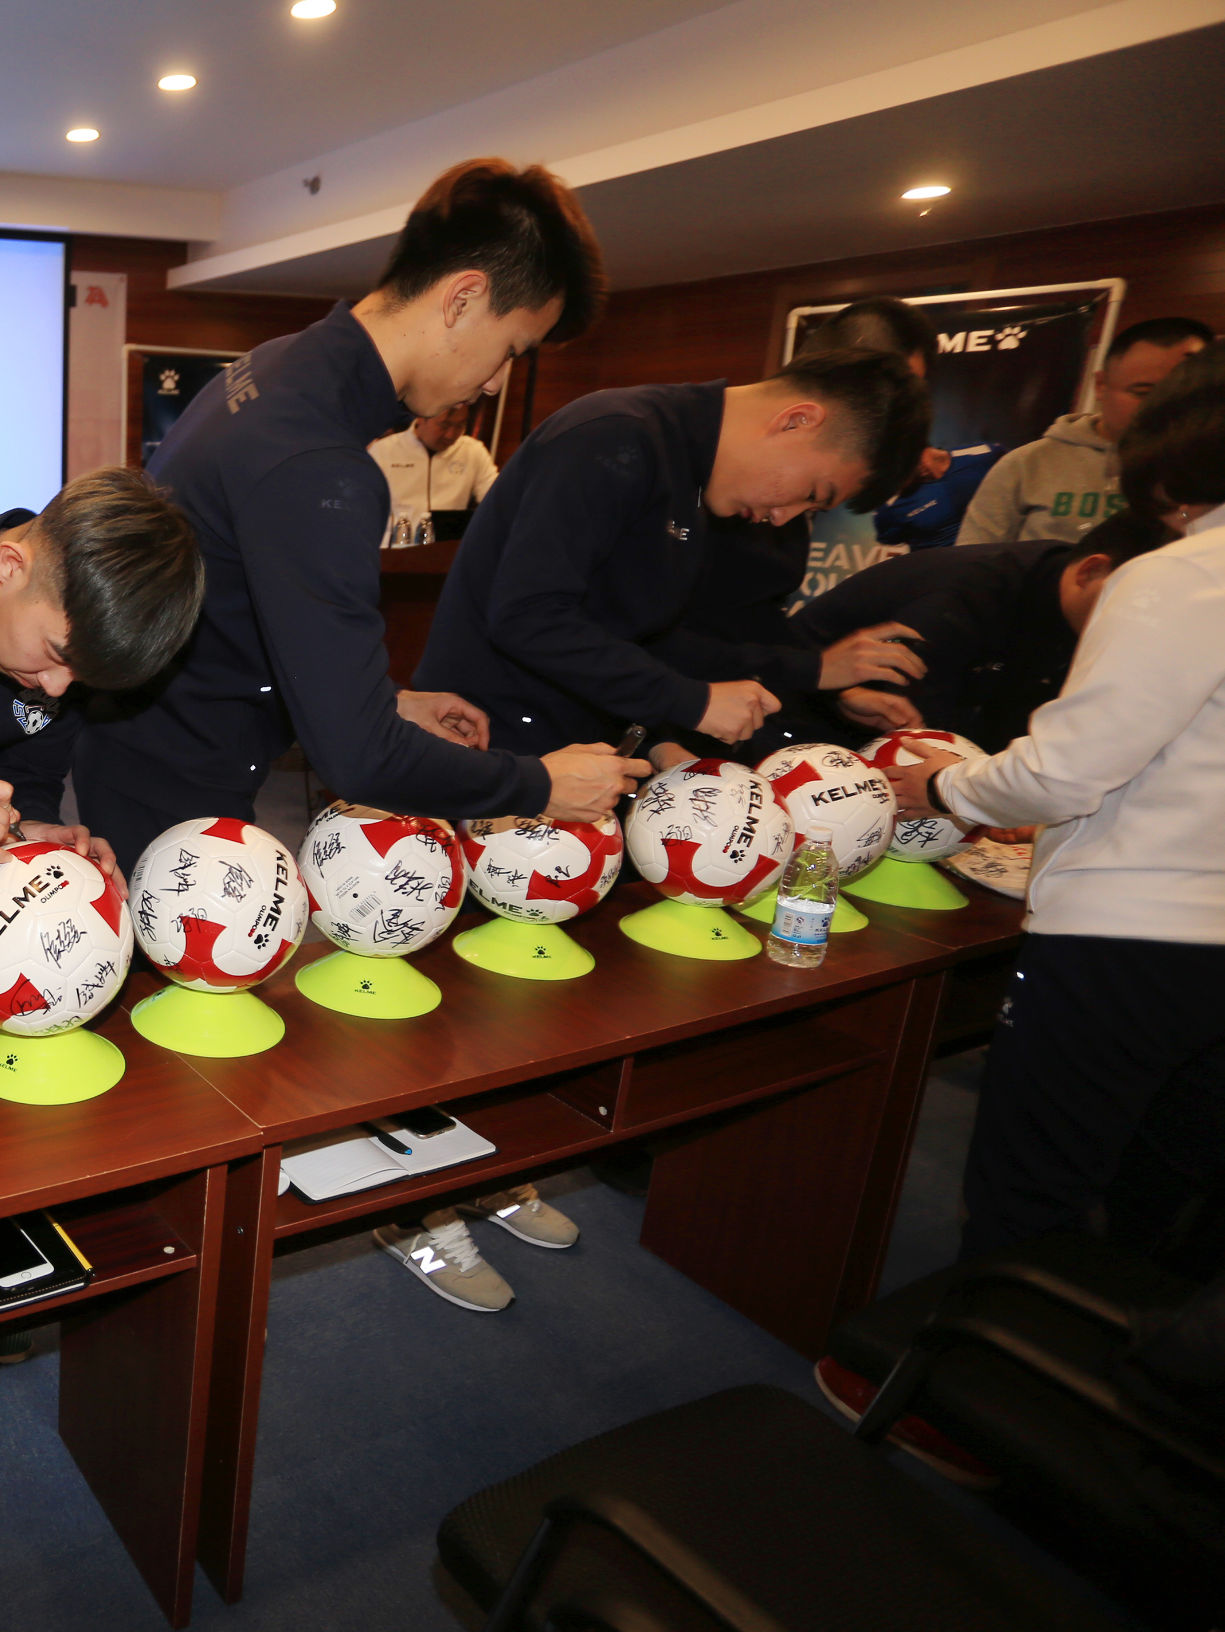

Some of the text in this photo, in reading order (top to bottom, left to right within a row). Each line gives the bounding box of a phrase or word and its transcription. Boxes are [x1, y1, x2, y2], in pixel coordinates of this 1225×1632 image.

[936, 329, 996, 354] ME
[1050, 491, 1128, 517] BOS
[810, 778, 882, 807] KELME
[737, 779, 764, 849] KELME
[263, 849, 289, 932] KELME
[469, 877, 523, 915] ELME
